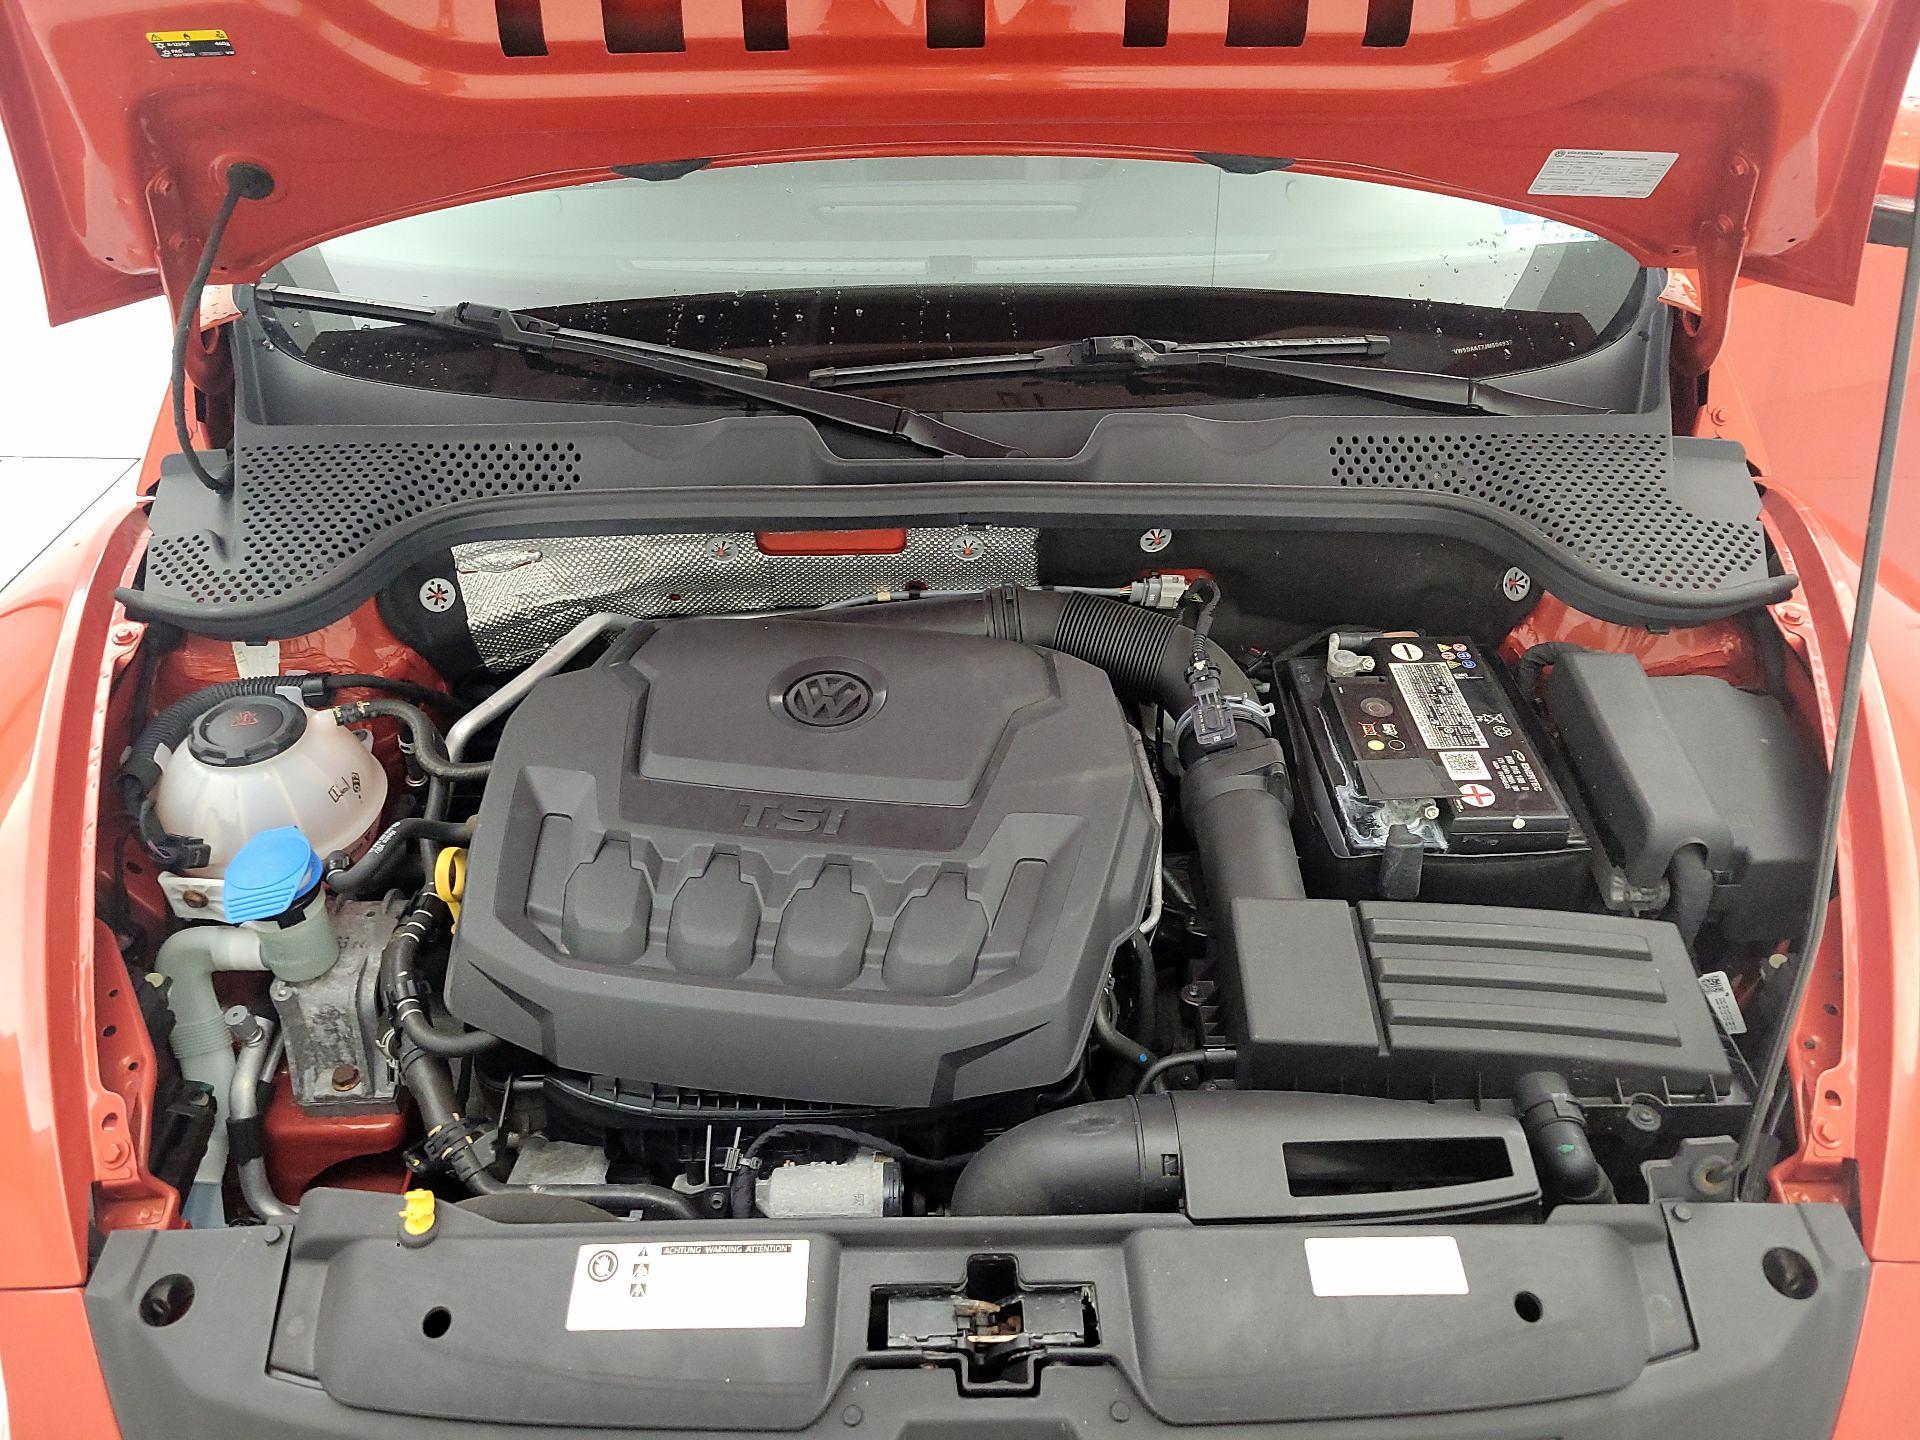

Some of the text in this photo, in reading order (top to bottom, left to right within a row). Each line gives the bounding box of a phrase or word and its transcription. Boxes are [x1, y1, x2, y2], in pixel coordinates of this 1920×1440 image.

[737, 801, 849, 835] TSI
[664, 1246, 701, 1254] ACHTUNG
[705, 1245, 743, 1254] WARNING
